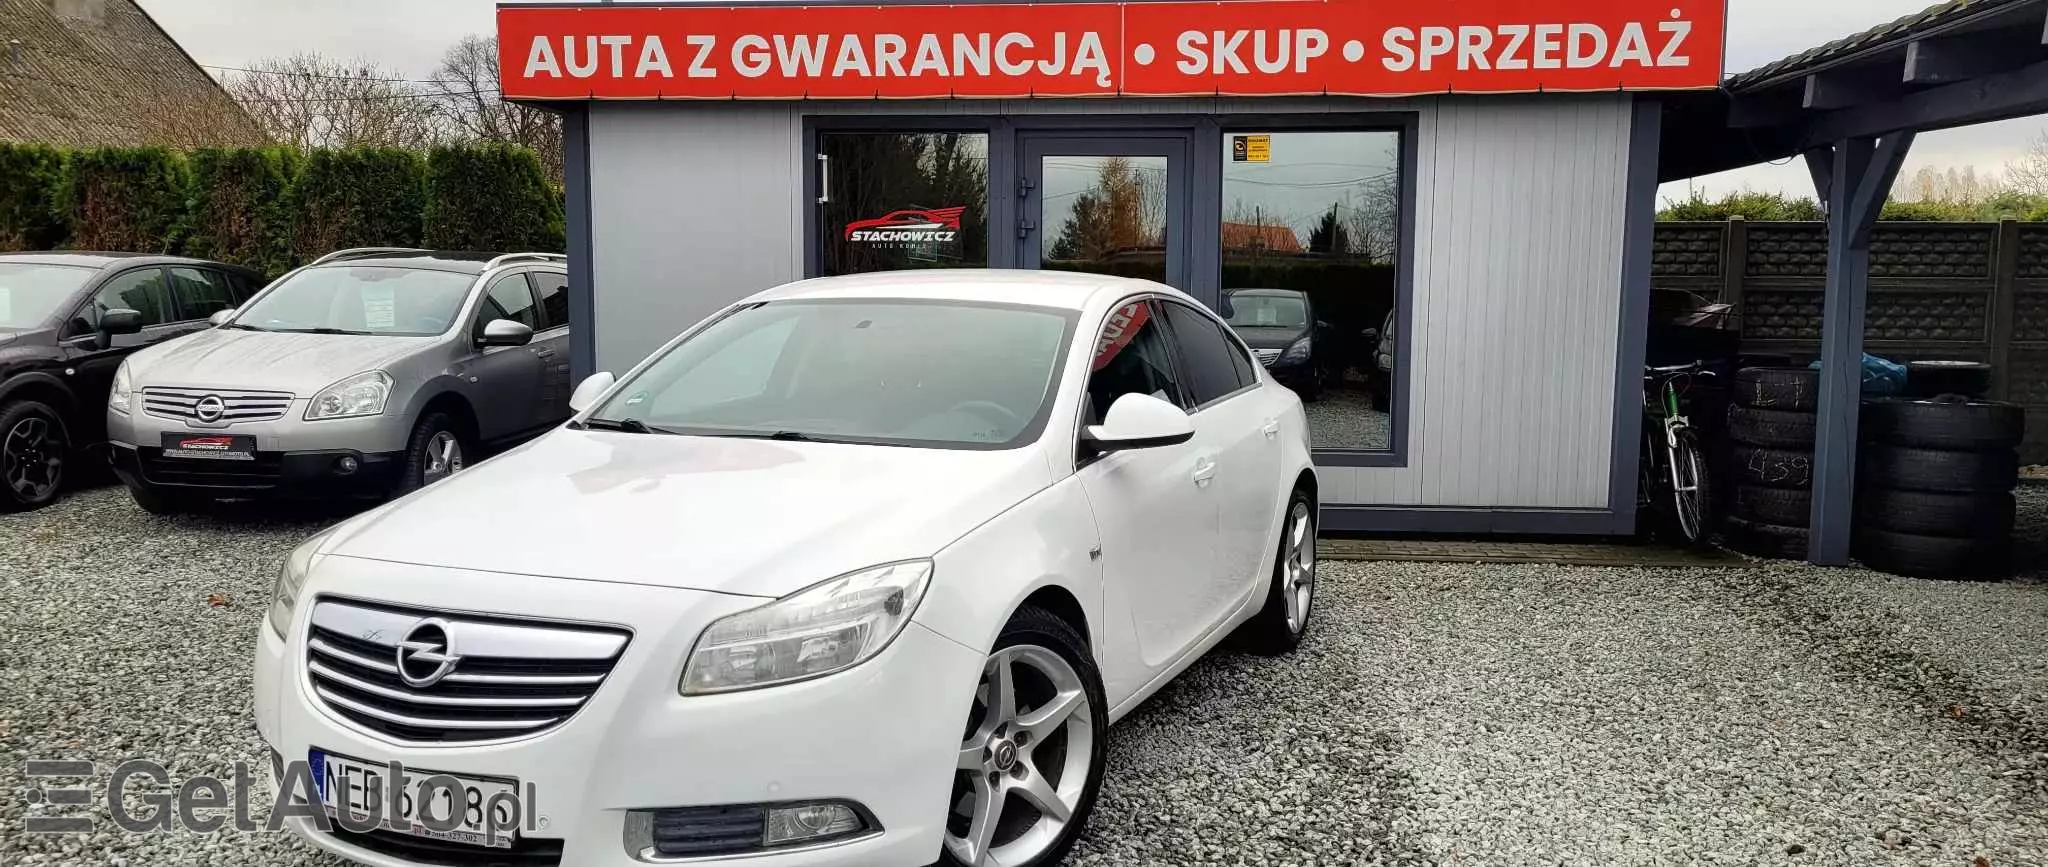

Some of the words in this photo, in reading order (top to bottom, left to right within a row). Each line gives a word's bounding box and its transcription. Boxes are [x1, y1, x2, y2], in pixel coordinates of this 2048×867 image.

[523, 34, 673, 78] AUTA
[686, 34, 716, 78] Z
[731, 31, 1112, 87] GWARANCJĄ
[1176, 28, 1329, 75] SKUP
[1381, 8, 1693, 72] SPRZEDAŻ
[850, 231, 956, 242] STACHOWICZ
